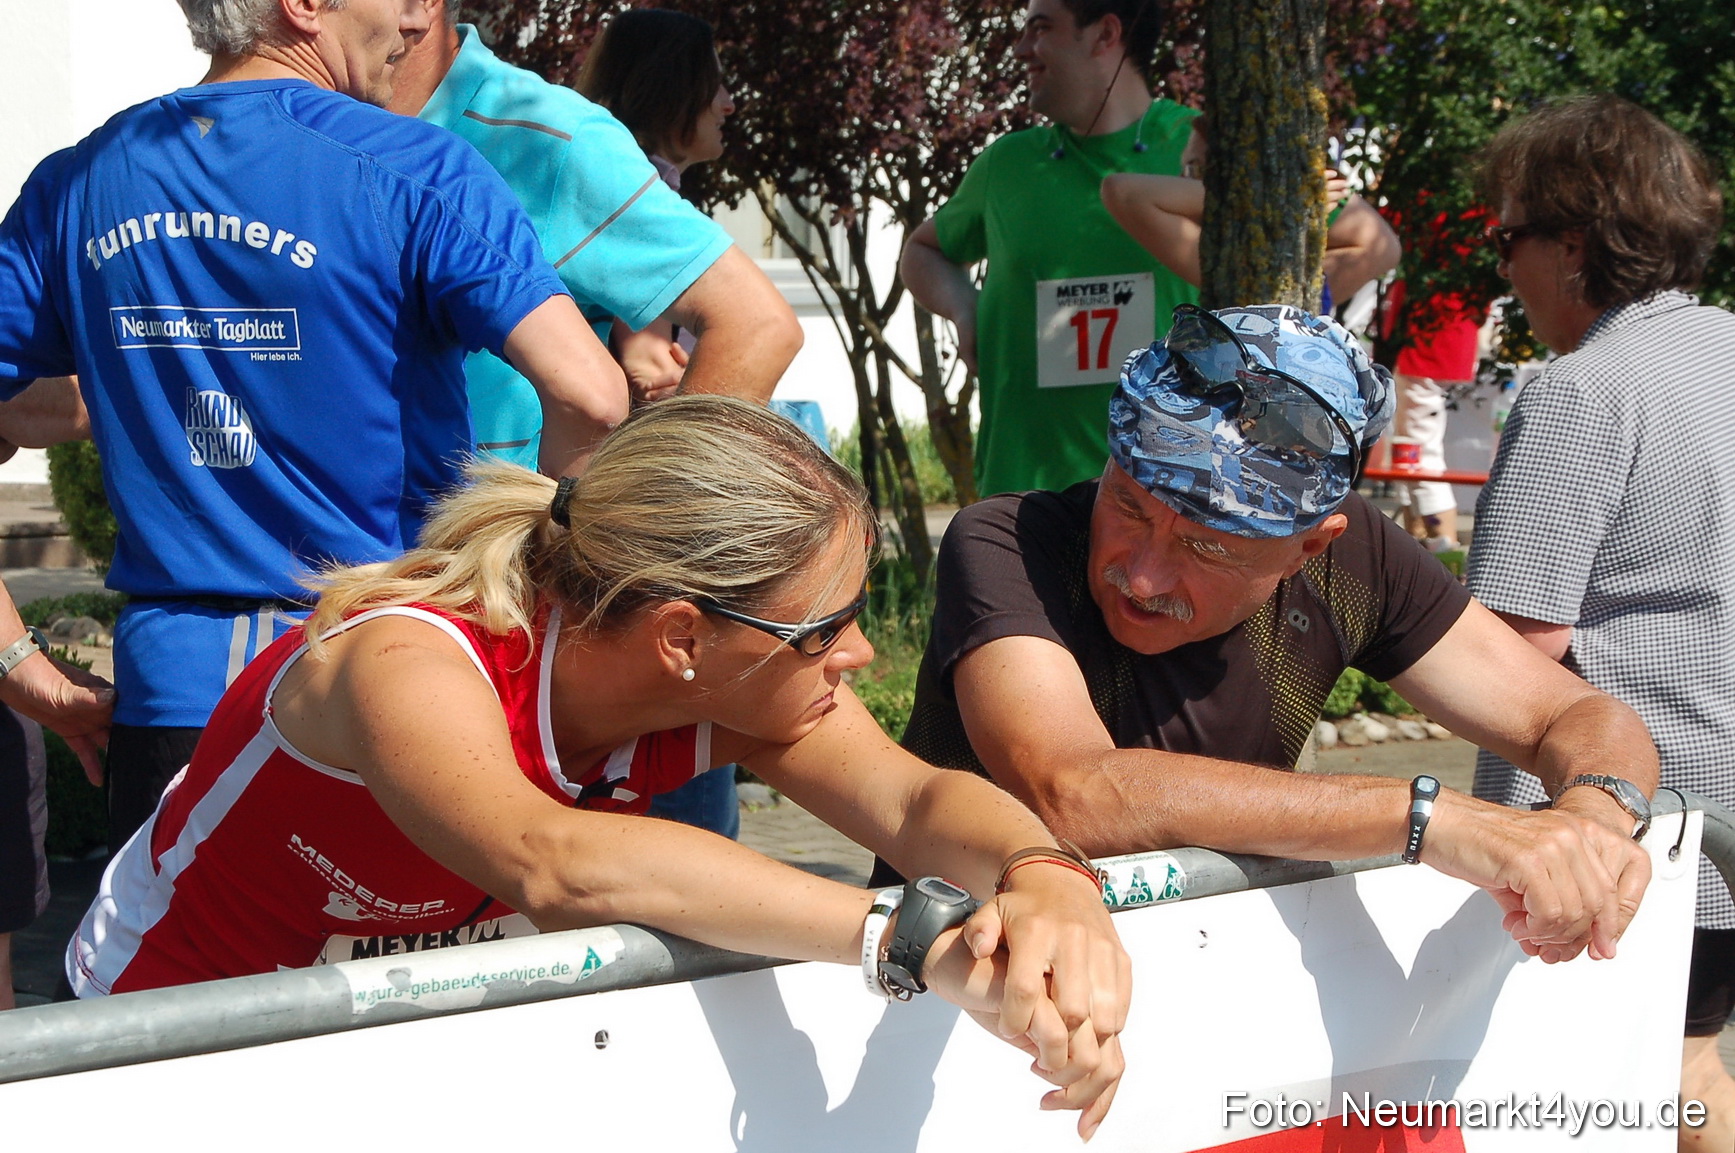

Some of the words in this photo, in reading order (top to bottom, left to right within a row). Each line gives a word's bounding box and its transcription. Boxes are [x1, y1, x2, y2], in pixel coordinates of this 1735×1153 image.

[86, 211, 318, 271] funrunners
[1057, 282, 1108, 297] MEYER
[1058, 295, 1111, 307] WERBUNG
[120, 316, 212, 339] Neumarkter
[213, 317, 286, 343] Tagblatt
[1070, 308, 1119, 371] 17
[250, 352, 268, 361] Hier
[268, 352, 286, 361] lebe
[186, 386, 243, 429] RUND
[189, 430, 257, 469] SCHAU
[290, 833, 445, 914] MEDERER
[351, 926, 463, 961] MEYER
